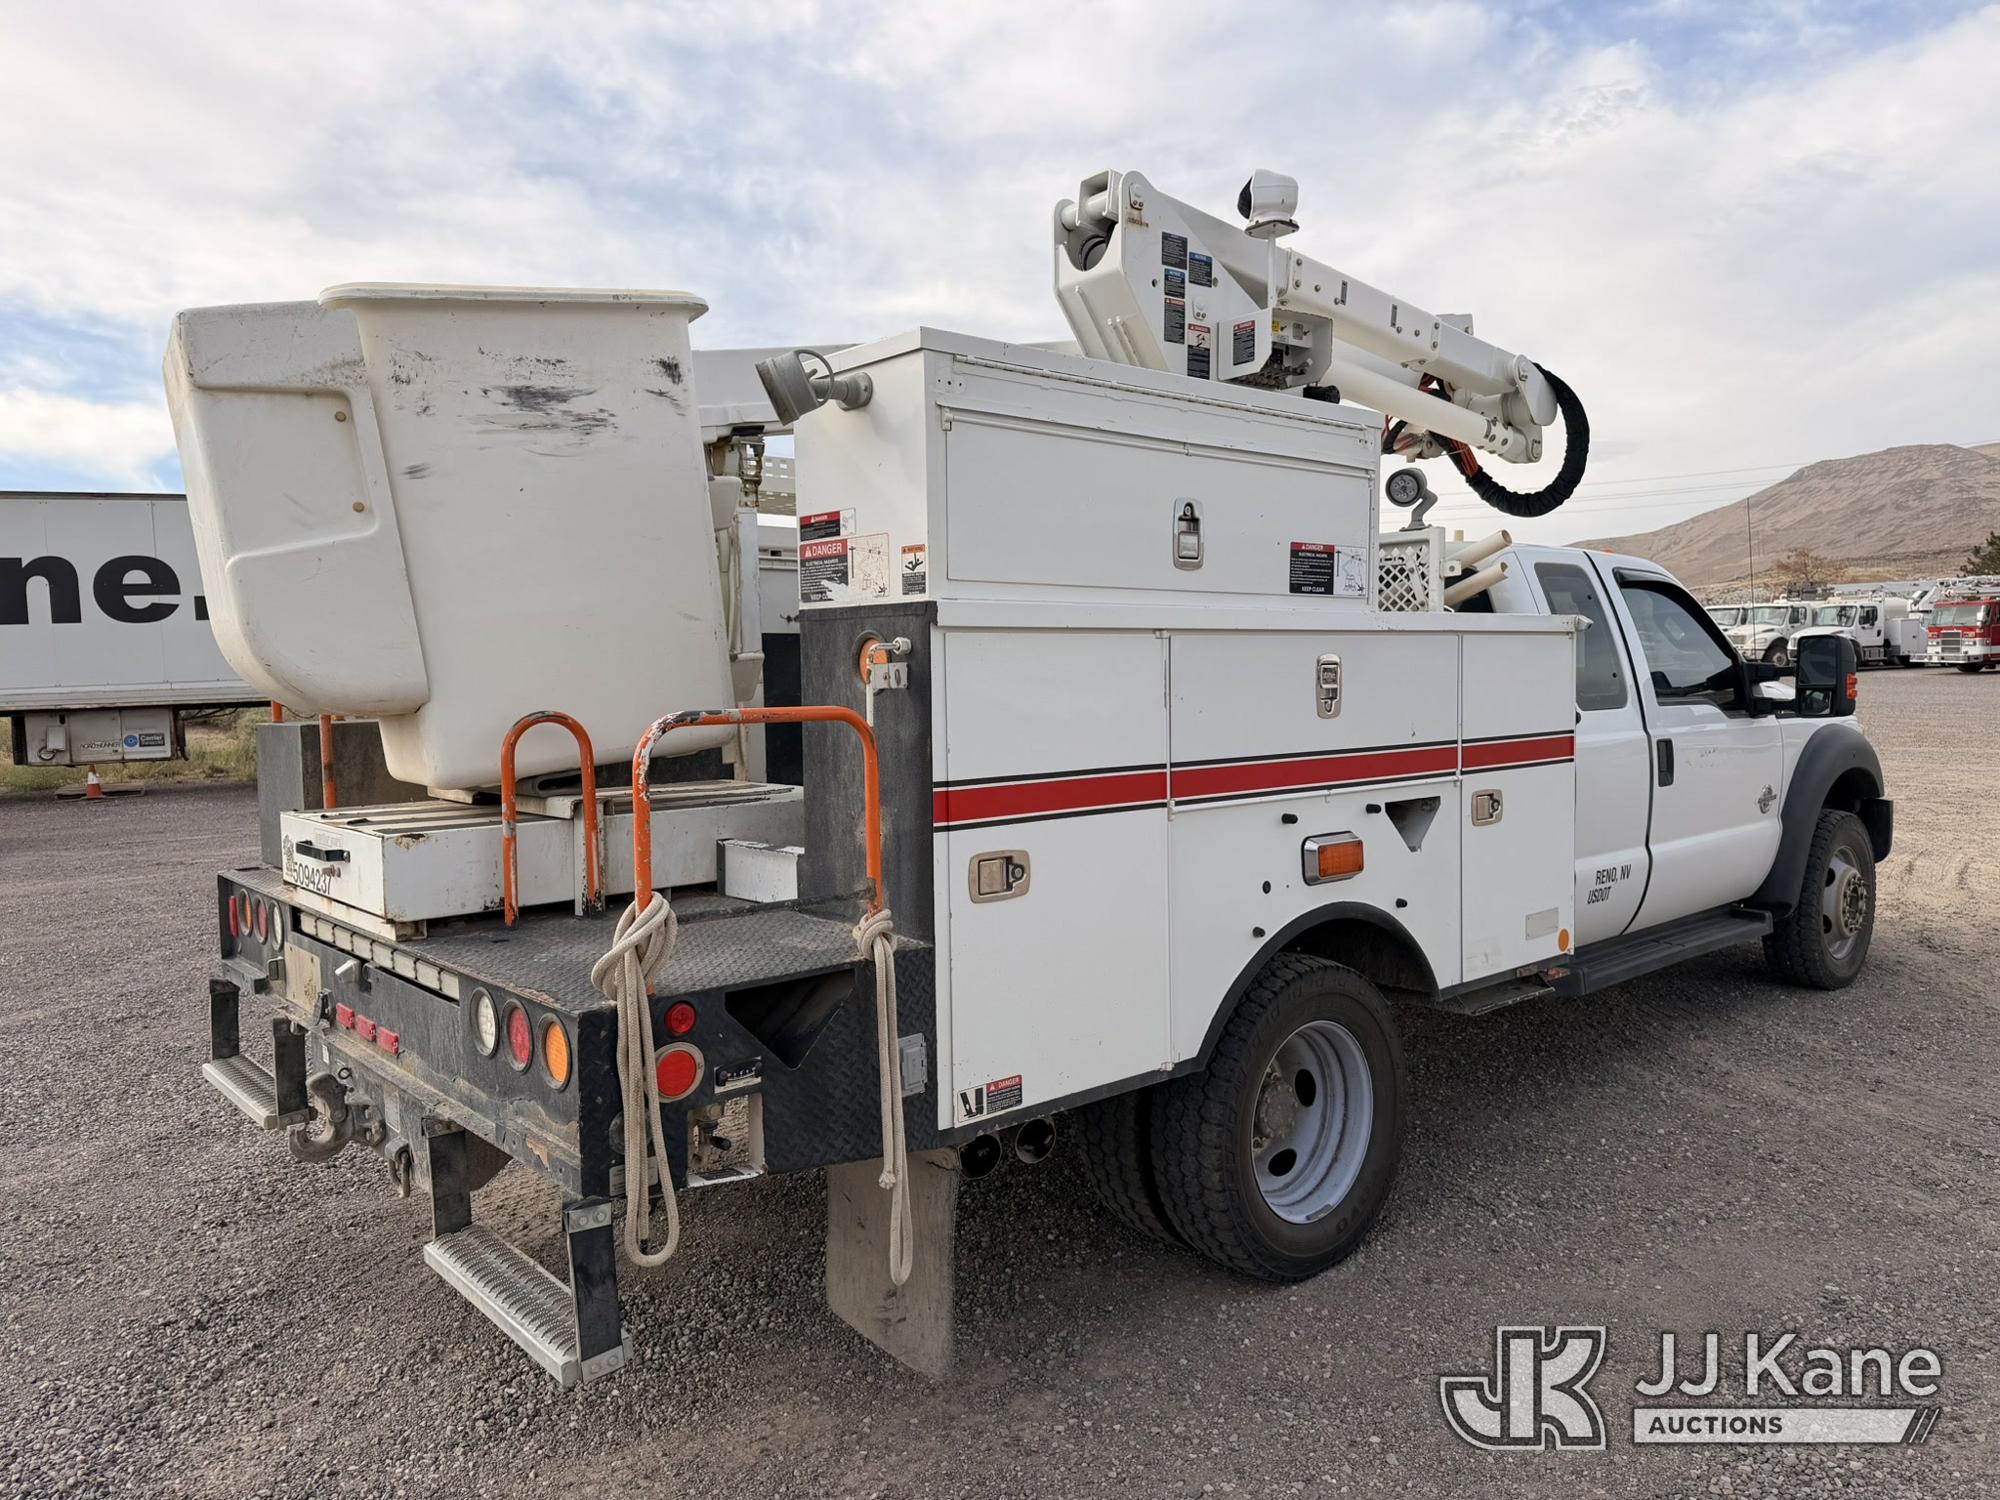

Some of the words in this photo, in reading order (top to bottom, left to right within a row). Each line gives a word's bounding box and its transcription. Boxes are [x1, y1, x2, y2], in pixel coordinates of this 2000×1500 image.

[812, 543, 843, 557] DANGER
[293, 860, 332, 896] 5094237
[1596, 867, 1617, 886] RENO,
[1620, 864, 1631, 880] NV
[1587, 886, 1611, 904] USDOT
